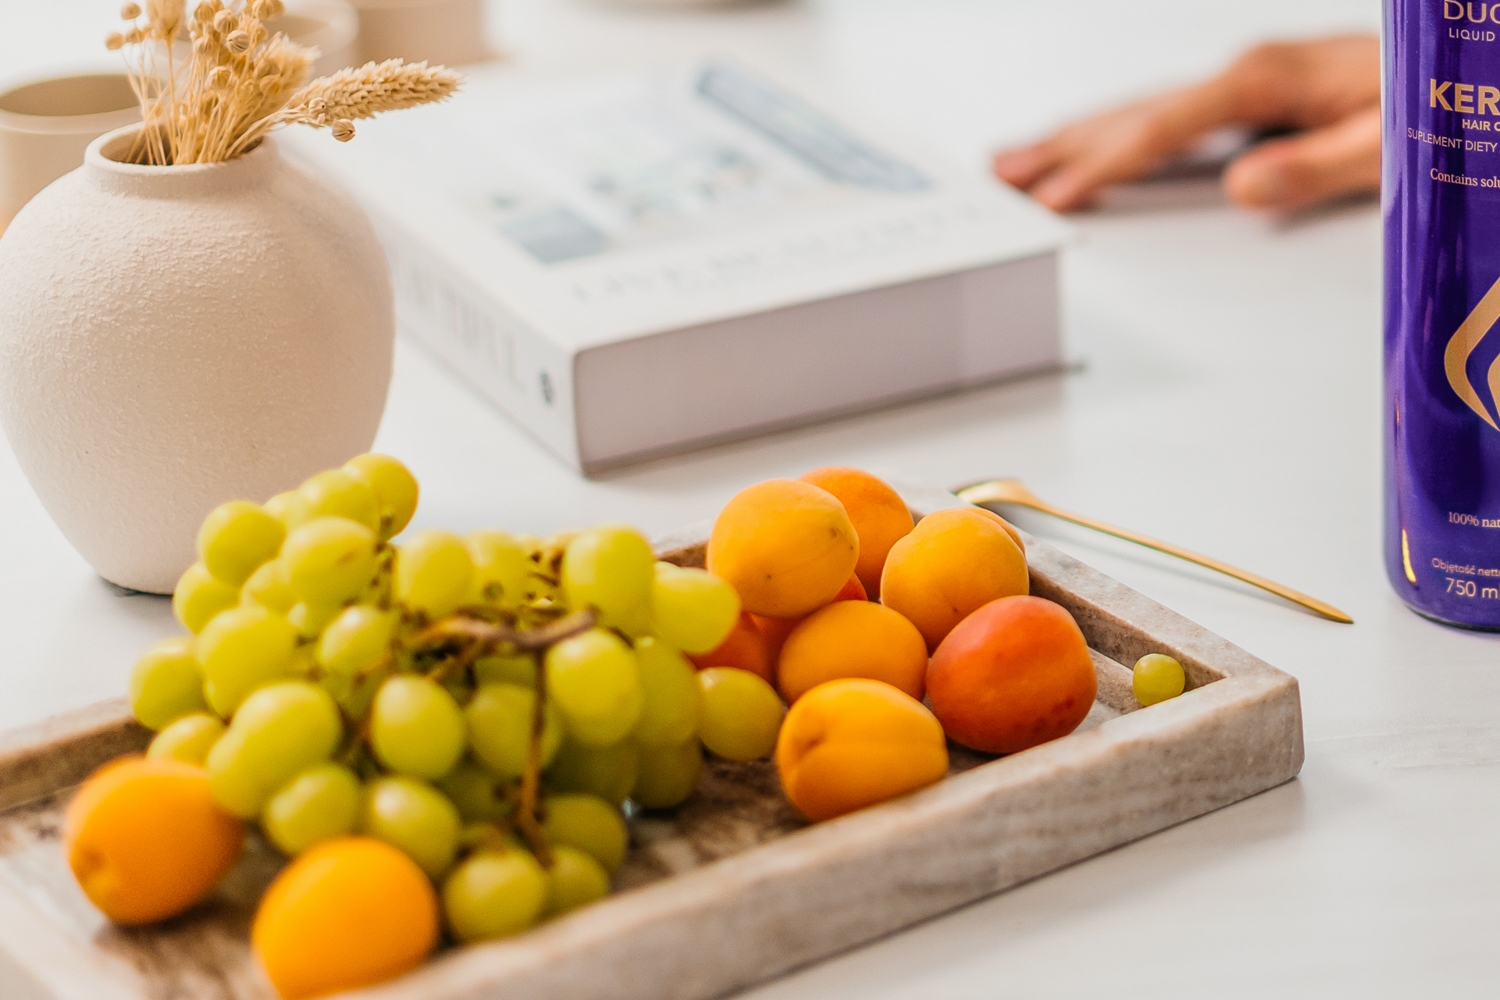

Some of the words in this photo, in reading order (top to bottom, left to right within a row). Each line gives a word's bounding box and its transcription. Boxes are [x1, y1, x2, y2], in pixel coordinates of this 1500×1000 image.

[1448, 27, 1496, 42] LIQUID
[1461, 118, 1491, 132] HAIR
[1407, 127, 1463, 149] SUPLEMENT
[1465, 140, 1499, 153] DIETY
[1430, 167, 1478, 187] Contains
[1448, 511, 1480, 527] 100%
[1445, 577, 1477, 598] 750
